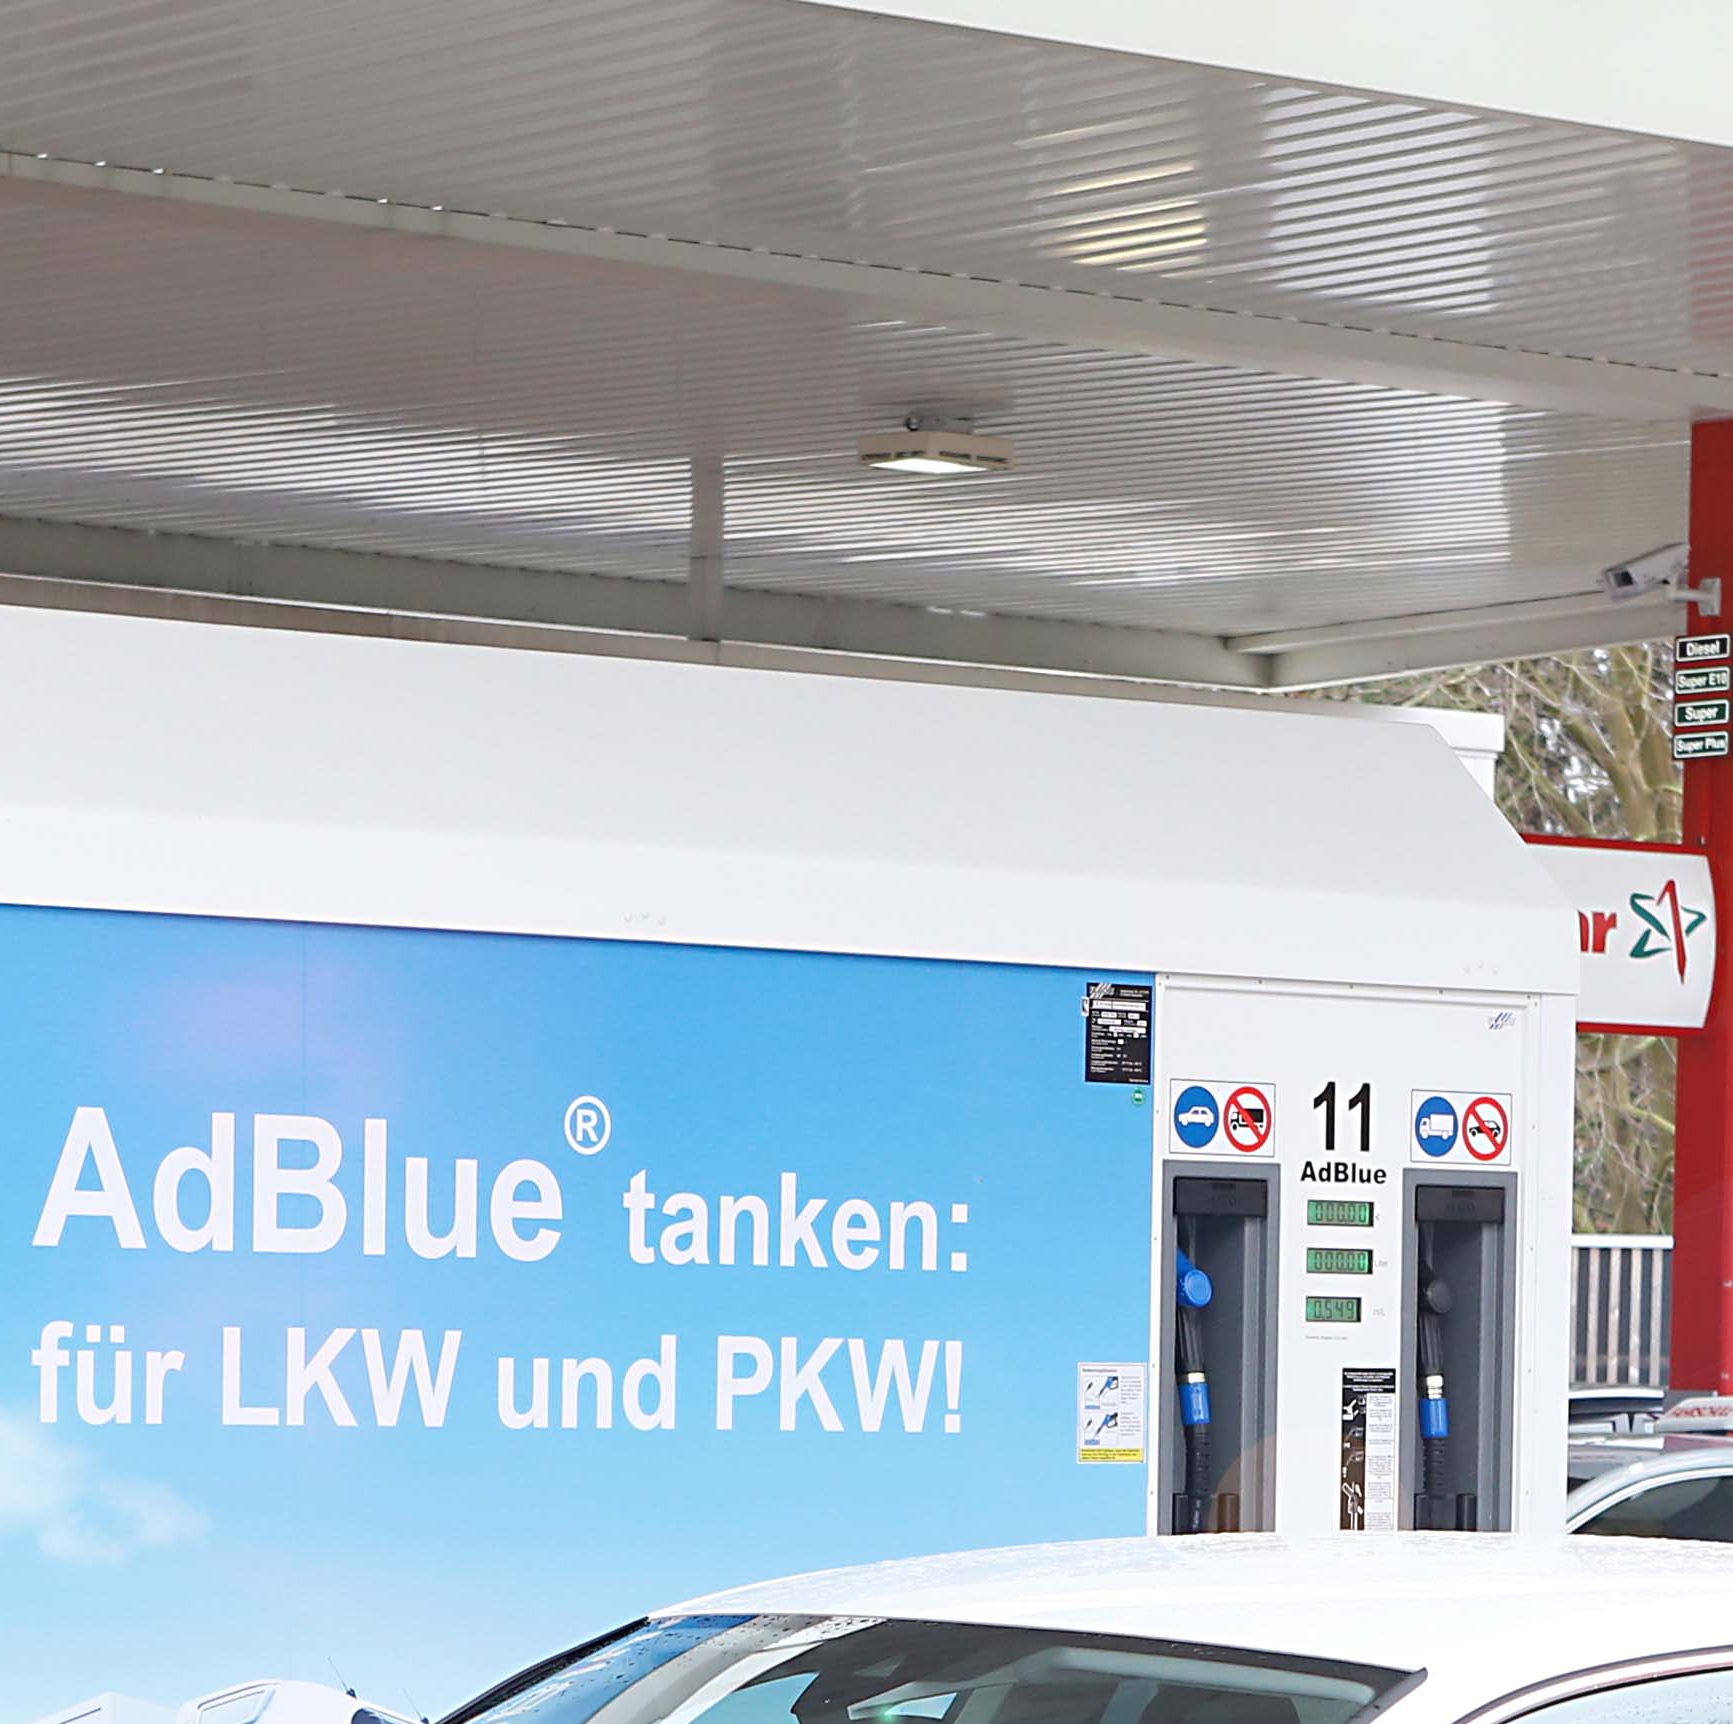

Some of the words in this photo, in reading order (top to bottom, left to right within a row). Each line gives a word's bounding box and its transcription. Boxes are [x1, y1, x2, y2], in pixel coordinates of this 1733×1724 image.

[1686, 640, 1720, 656] Diesel
[1678, 676, 1706, 690] Super
[1708, 673, 1727, 685] E10
[1685, 707, 1718, 723] Super
[1677, 740, 1703, 754] Super
[1705, 737, 1725, 749] Plus
[1313, 1081, 1371, 1152] 11
[1300, 1161, 1387, 1186] AdBlue
[622, 1170, 969, 1272] tanken:
[32, 1319, 184, 1426] für
[221, 1326, 462, 1427] LKW
[497, 1335, 677, 1431] und
[715, 1335, 963, 1434] PKW!
